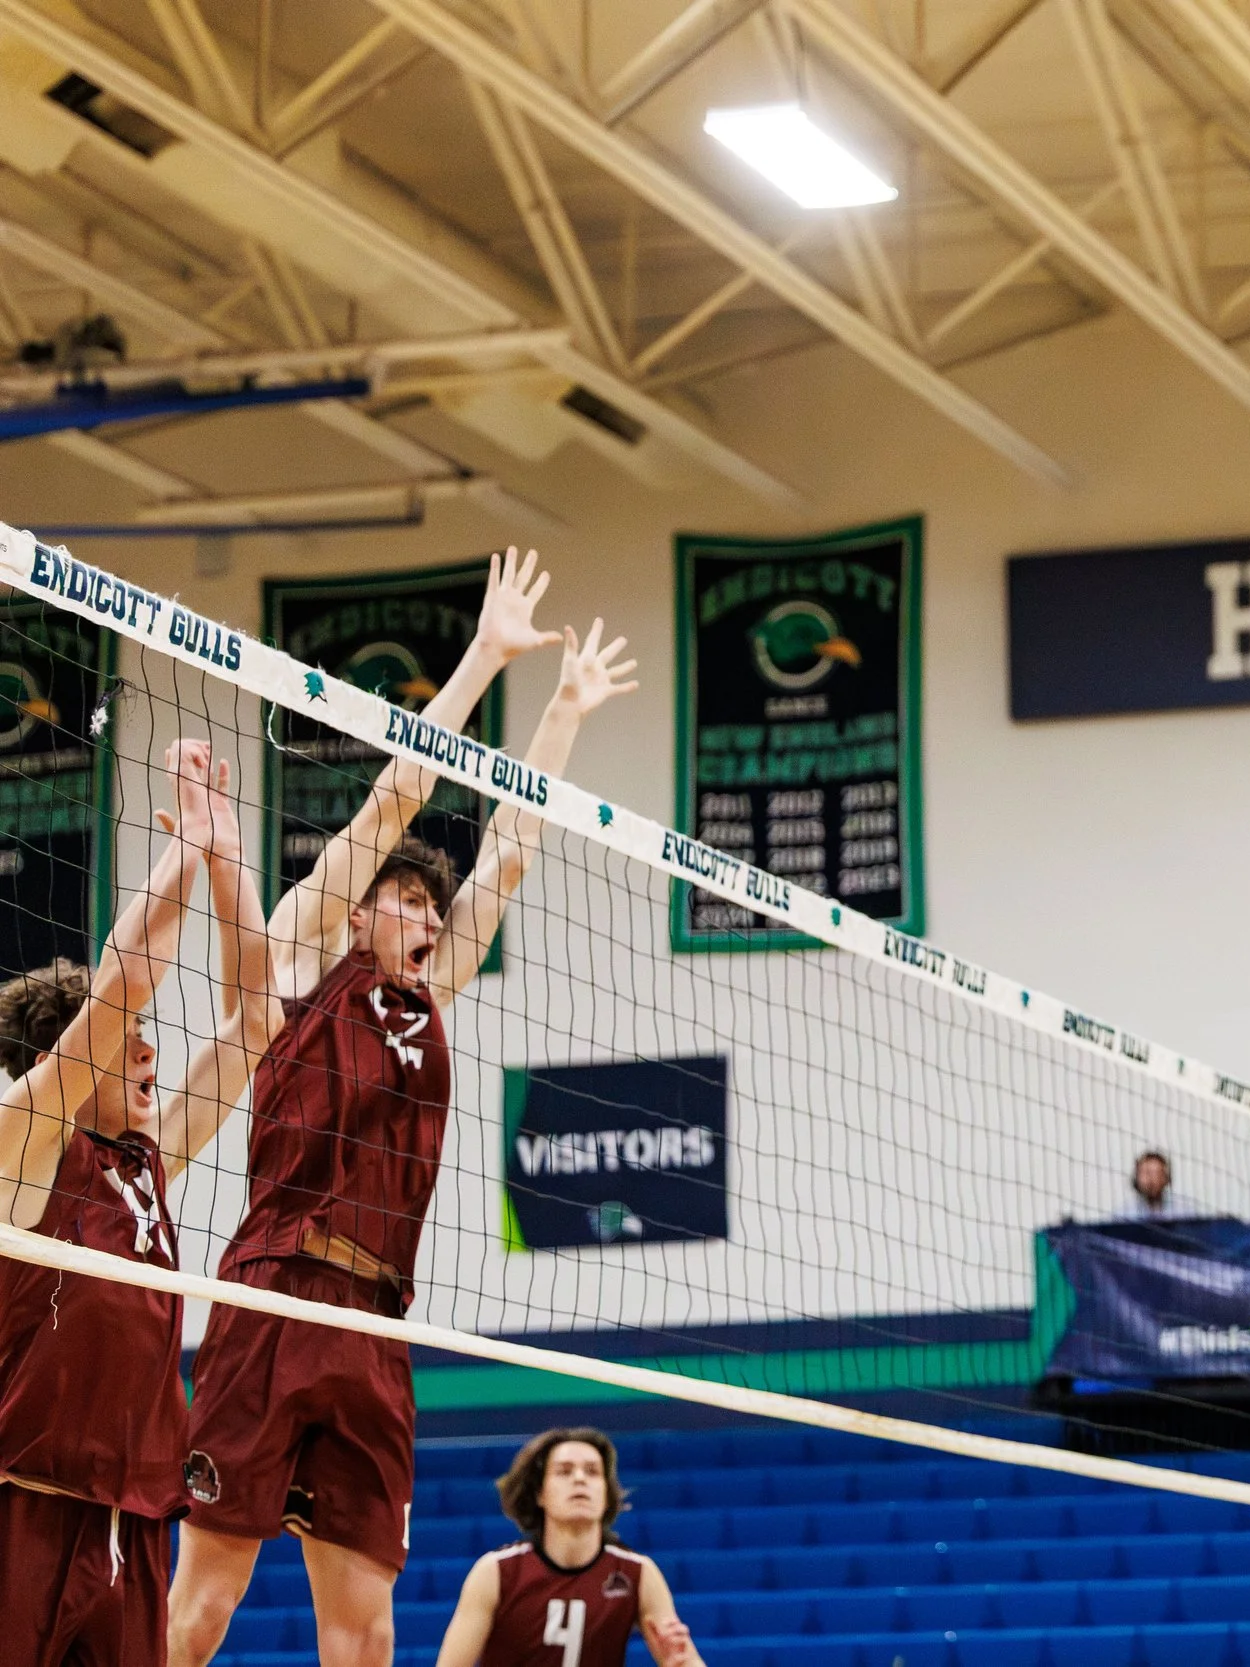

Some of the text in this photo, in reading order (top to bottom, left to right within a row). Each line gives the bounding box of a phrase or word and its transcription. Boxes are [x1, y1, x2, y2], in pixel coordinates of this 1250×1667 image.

[30, 544, 242, 671] ENDICOTT GULLS
[385, 706, 486, 778] ENDICOTT
[492, 753, 548, 806] GULLS
[661, 831, 740, 890] ENDICOTT
[516, 1125, 715, 1177] VISITORS
[543, 1598, 587, 1667] 4
